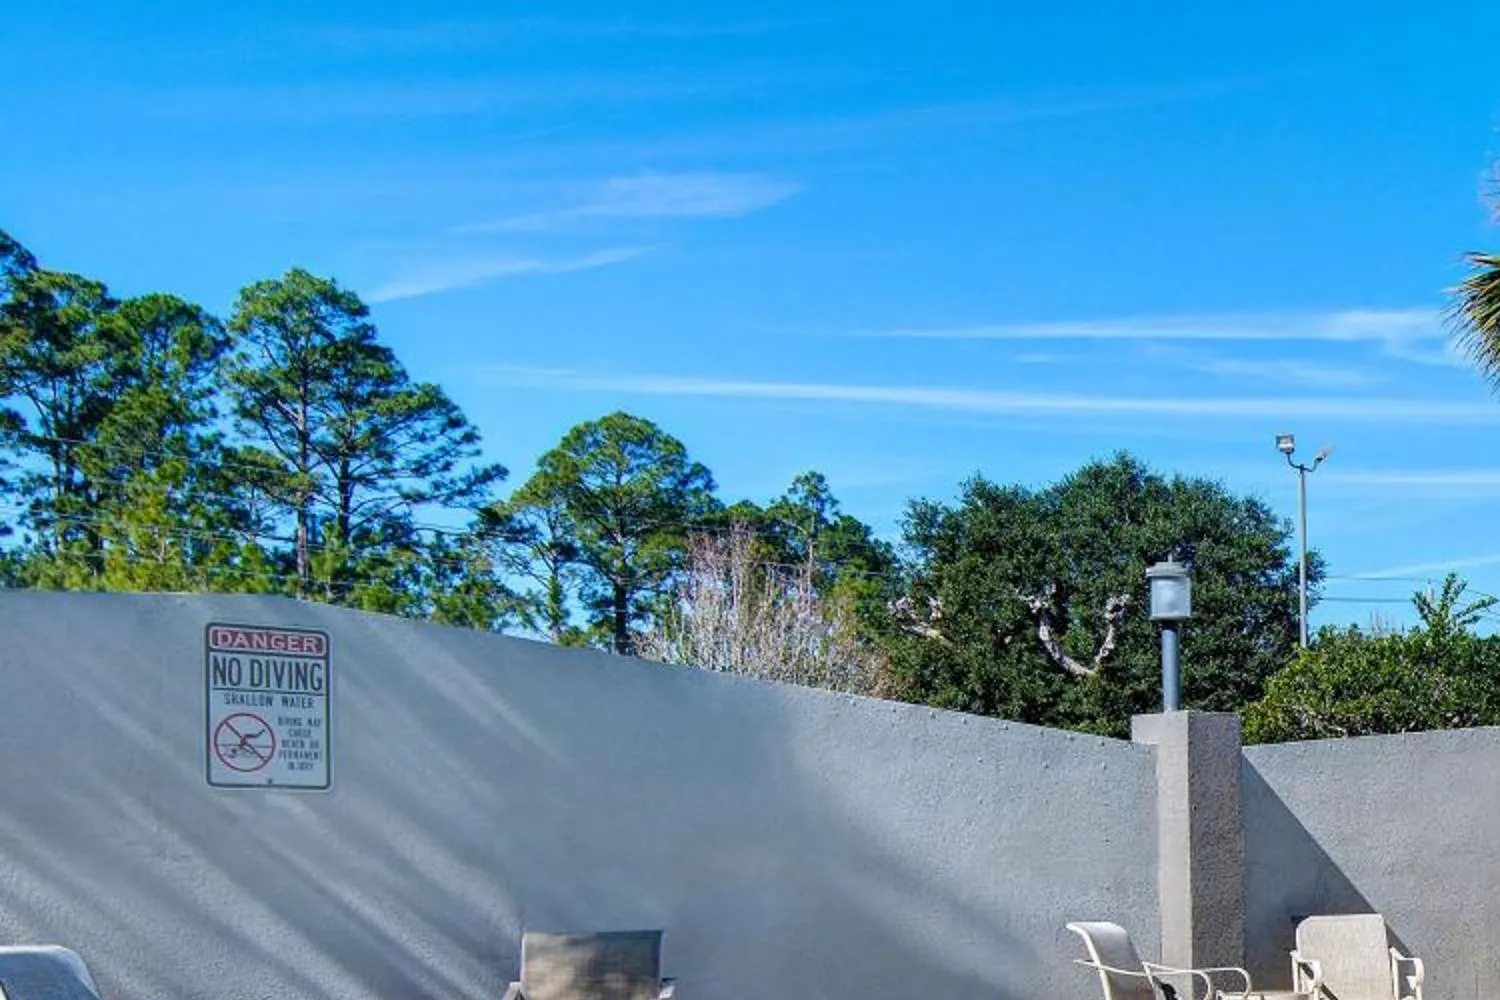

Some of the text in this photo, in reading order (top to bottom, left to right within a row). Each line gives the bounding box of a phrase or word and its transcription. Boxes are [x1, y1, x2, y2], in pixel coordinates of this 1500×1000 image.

[217, 630, 319, 653] DANGER
[213, 655, 322, 691] NO DIVING
[224, 692, 315, 709] SHALLOW WATER
